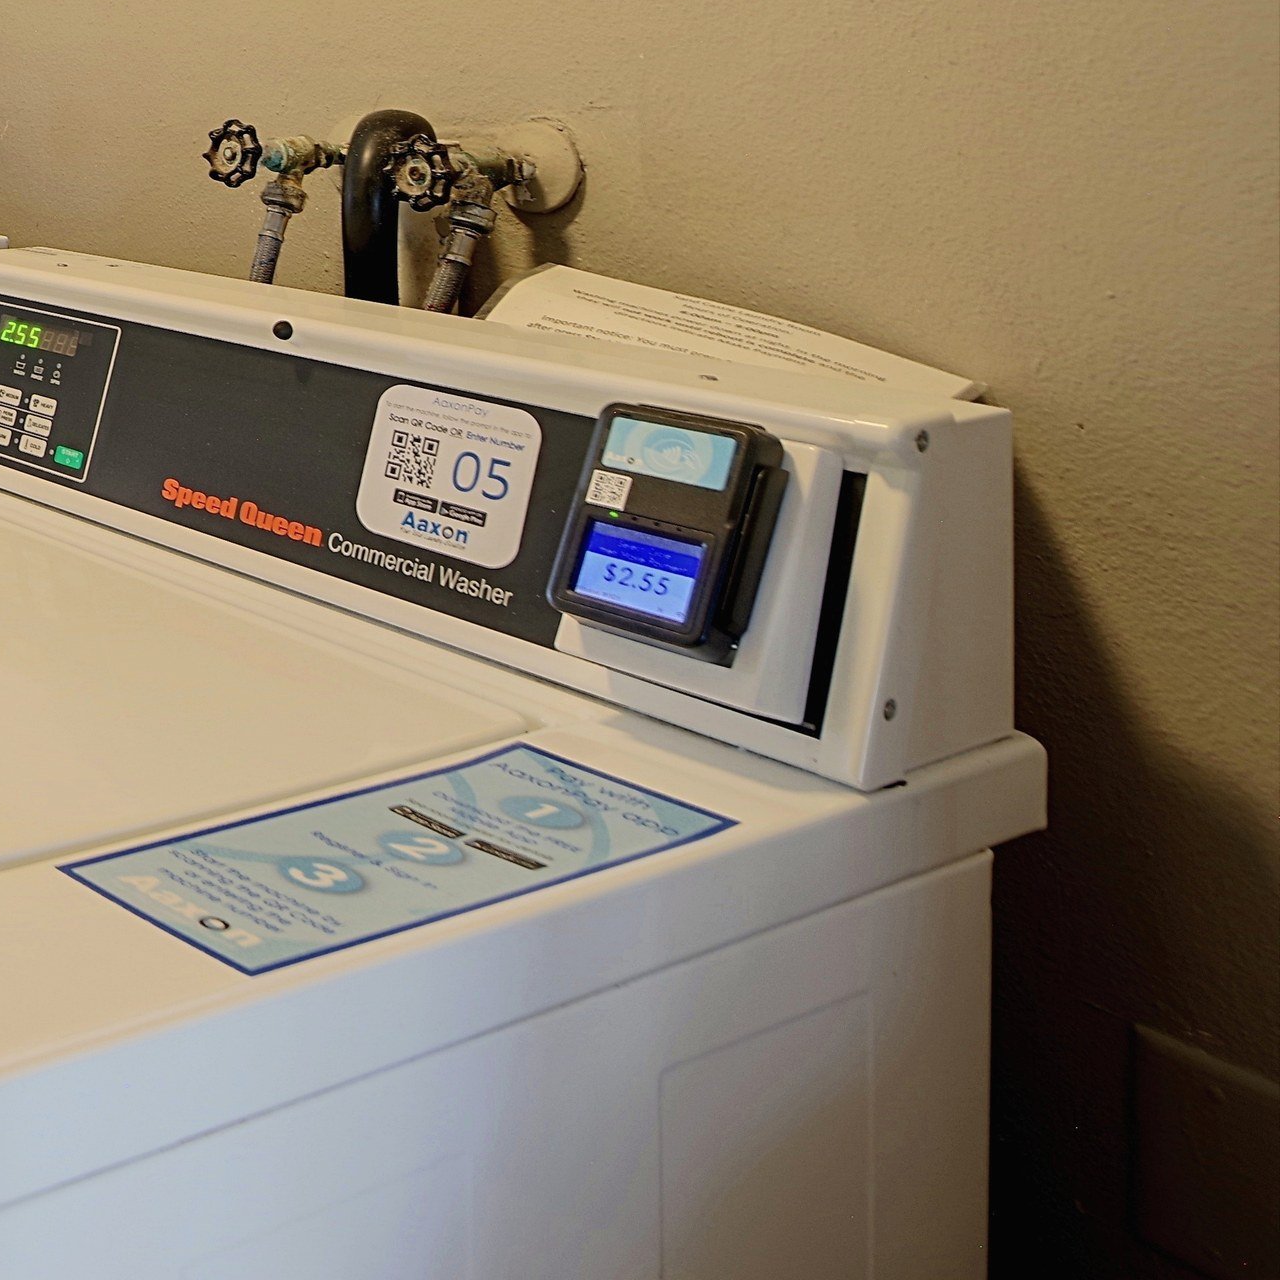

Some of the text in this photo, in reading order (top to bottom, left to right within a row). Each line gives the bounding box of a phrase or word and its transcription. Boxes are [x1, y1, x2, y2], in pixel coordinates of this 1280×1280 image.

[1, 321, 42, 348] 2.55
[526, 322, 553, 331] after
[541, 314, 595, 332] Important
[636, 336, 657, 347] You
[658, 343, 689, 354] must
[40, 402, 54, 410] HEAVY
[433, 397, 488, 418] AaxonPay
[389, 413, 525, 451] Scan QR Code OR Enter Number
[452, 451, 512, 500] 05
[162, 477, 237, 520] Speed
[240, 501, 323, 548] Queen
[327, 531, 435, 583] Commercial
[439, 564, 513, 607] Washer
[401, 511, 468, 544] Aaxon
[603, 563, 671, 596] $2.55
[490, 762, 679, 836] AaxonPay app
[546, 767, 651, 809] Pay with
[525, 804, 559, 818] 1
[389, 836, 450, 861] 2
[158, 867, 222, 903] machine
[237, 884, 261, 899] the
[289, 862, 348, 888] 3
[117, 875, 263, 948] Aaxon
[254, 882, 320, 915] machine
[266, 910, 292, 926] the
